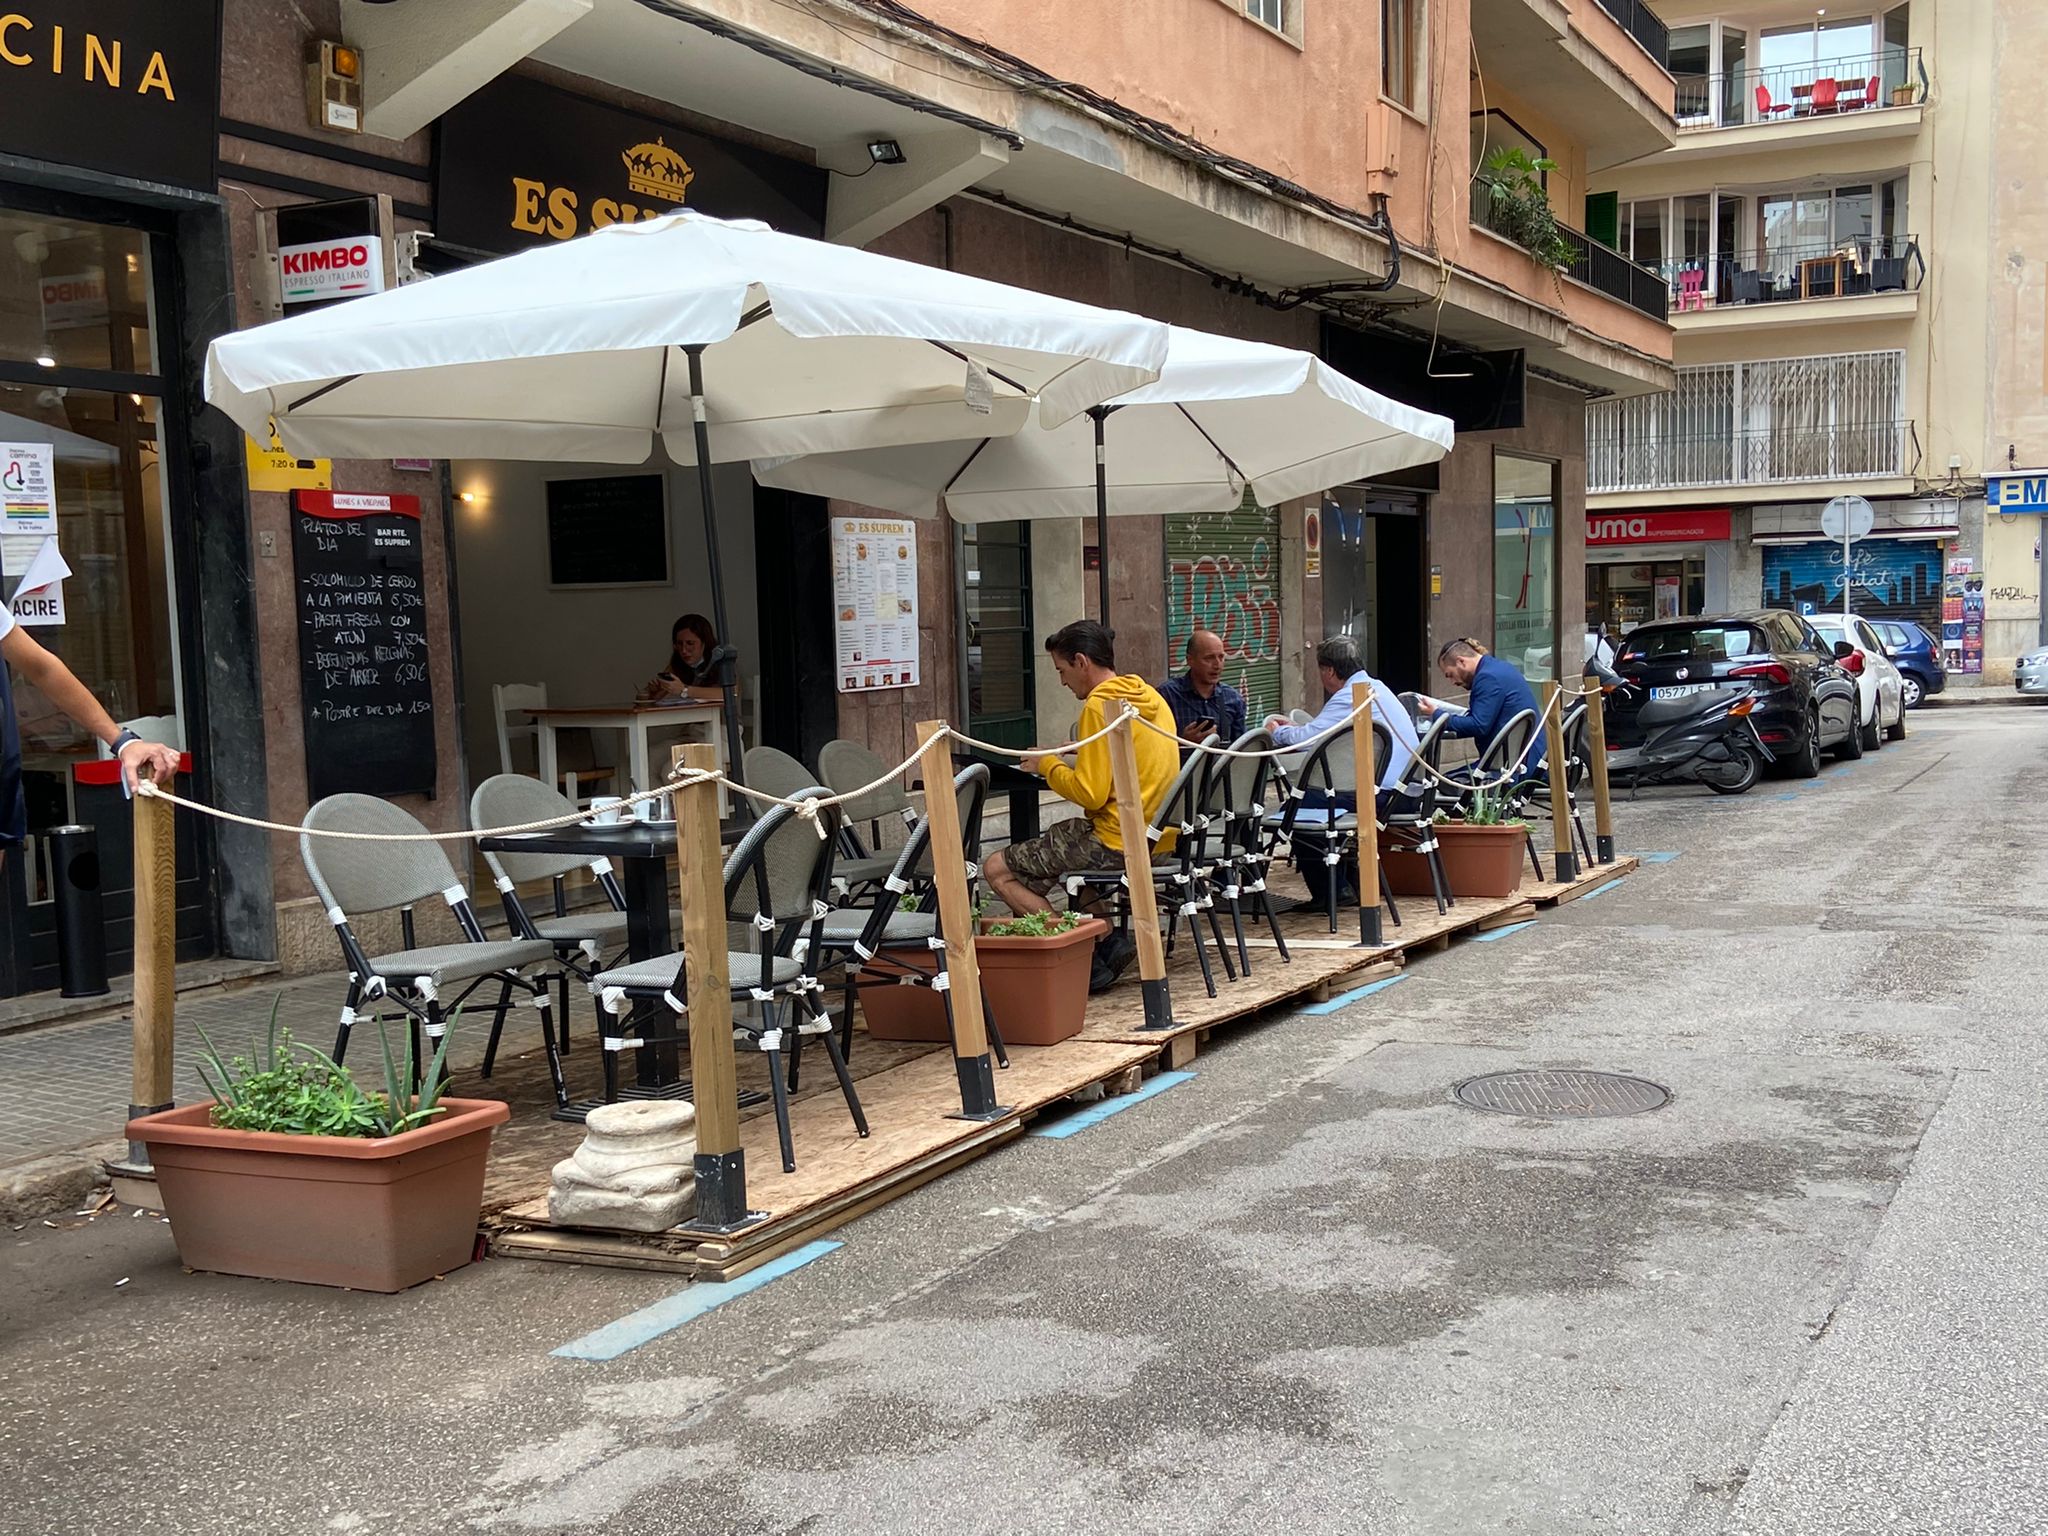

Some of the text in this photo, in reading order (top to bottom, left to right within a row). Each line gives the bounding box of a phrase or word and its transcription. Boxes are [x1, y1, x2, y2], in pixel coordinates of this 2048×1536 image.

[511, 177, 578, 240] ES
[283, 245, 367, 275] KIMBO
[284, 269, 370, 288] ESPRESSO ITALIANO
[859, 521, 904, 533] ES SUPREM
[317, 537, 339, 552] DIA
[374, 538, 411, 547] ES SUPREM
[370, 574, 383, 588] DE
[388, 575, 417, 588] CERDO
[306, 593, 315, 606] A
[318, 593, 331, 607] LA
[334, 591, 383, 606] PIMIENTA
[13, 599, 58, 616] ACIRE
[312, 611, 342, 629] PASTA
[391, 614, 410, 627] CON
[335, 629, 365, 645] ATUN
[325, 669, 347, 689] DE
[1658, 687, 1686, 698] 0577
[321, 699, 360, 721] POSTRE
